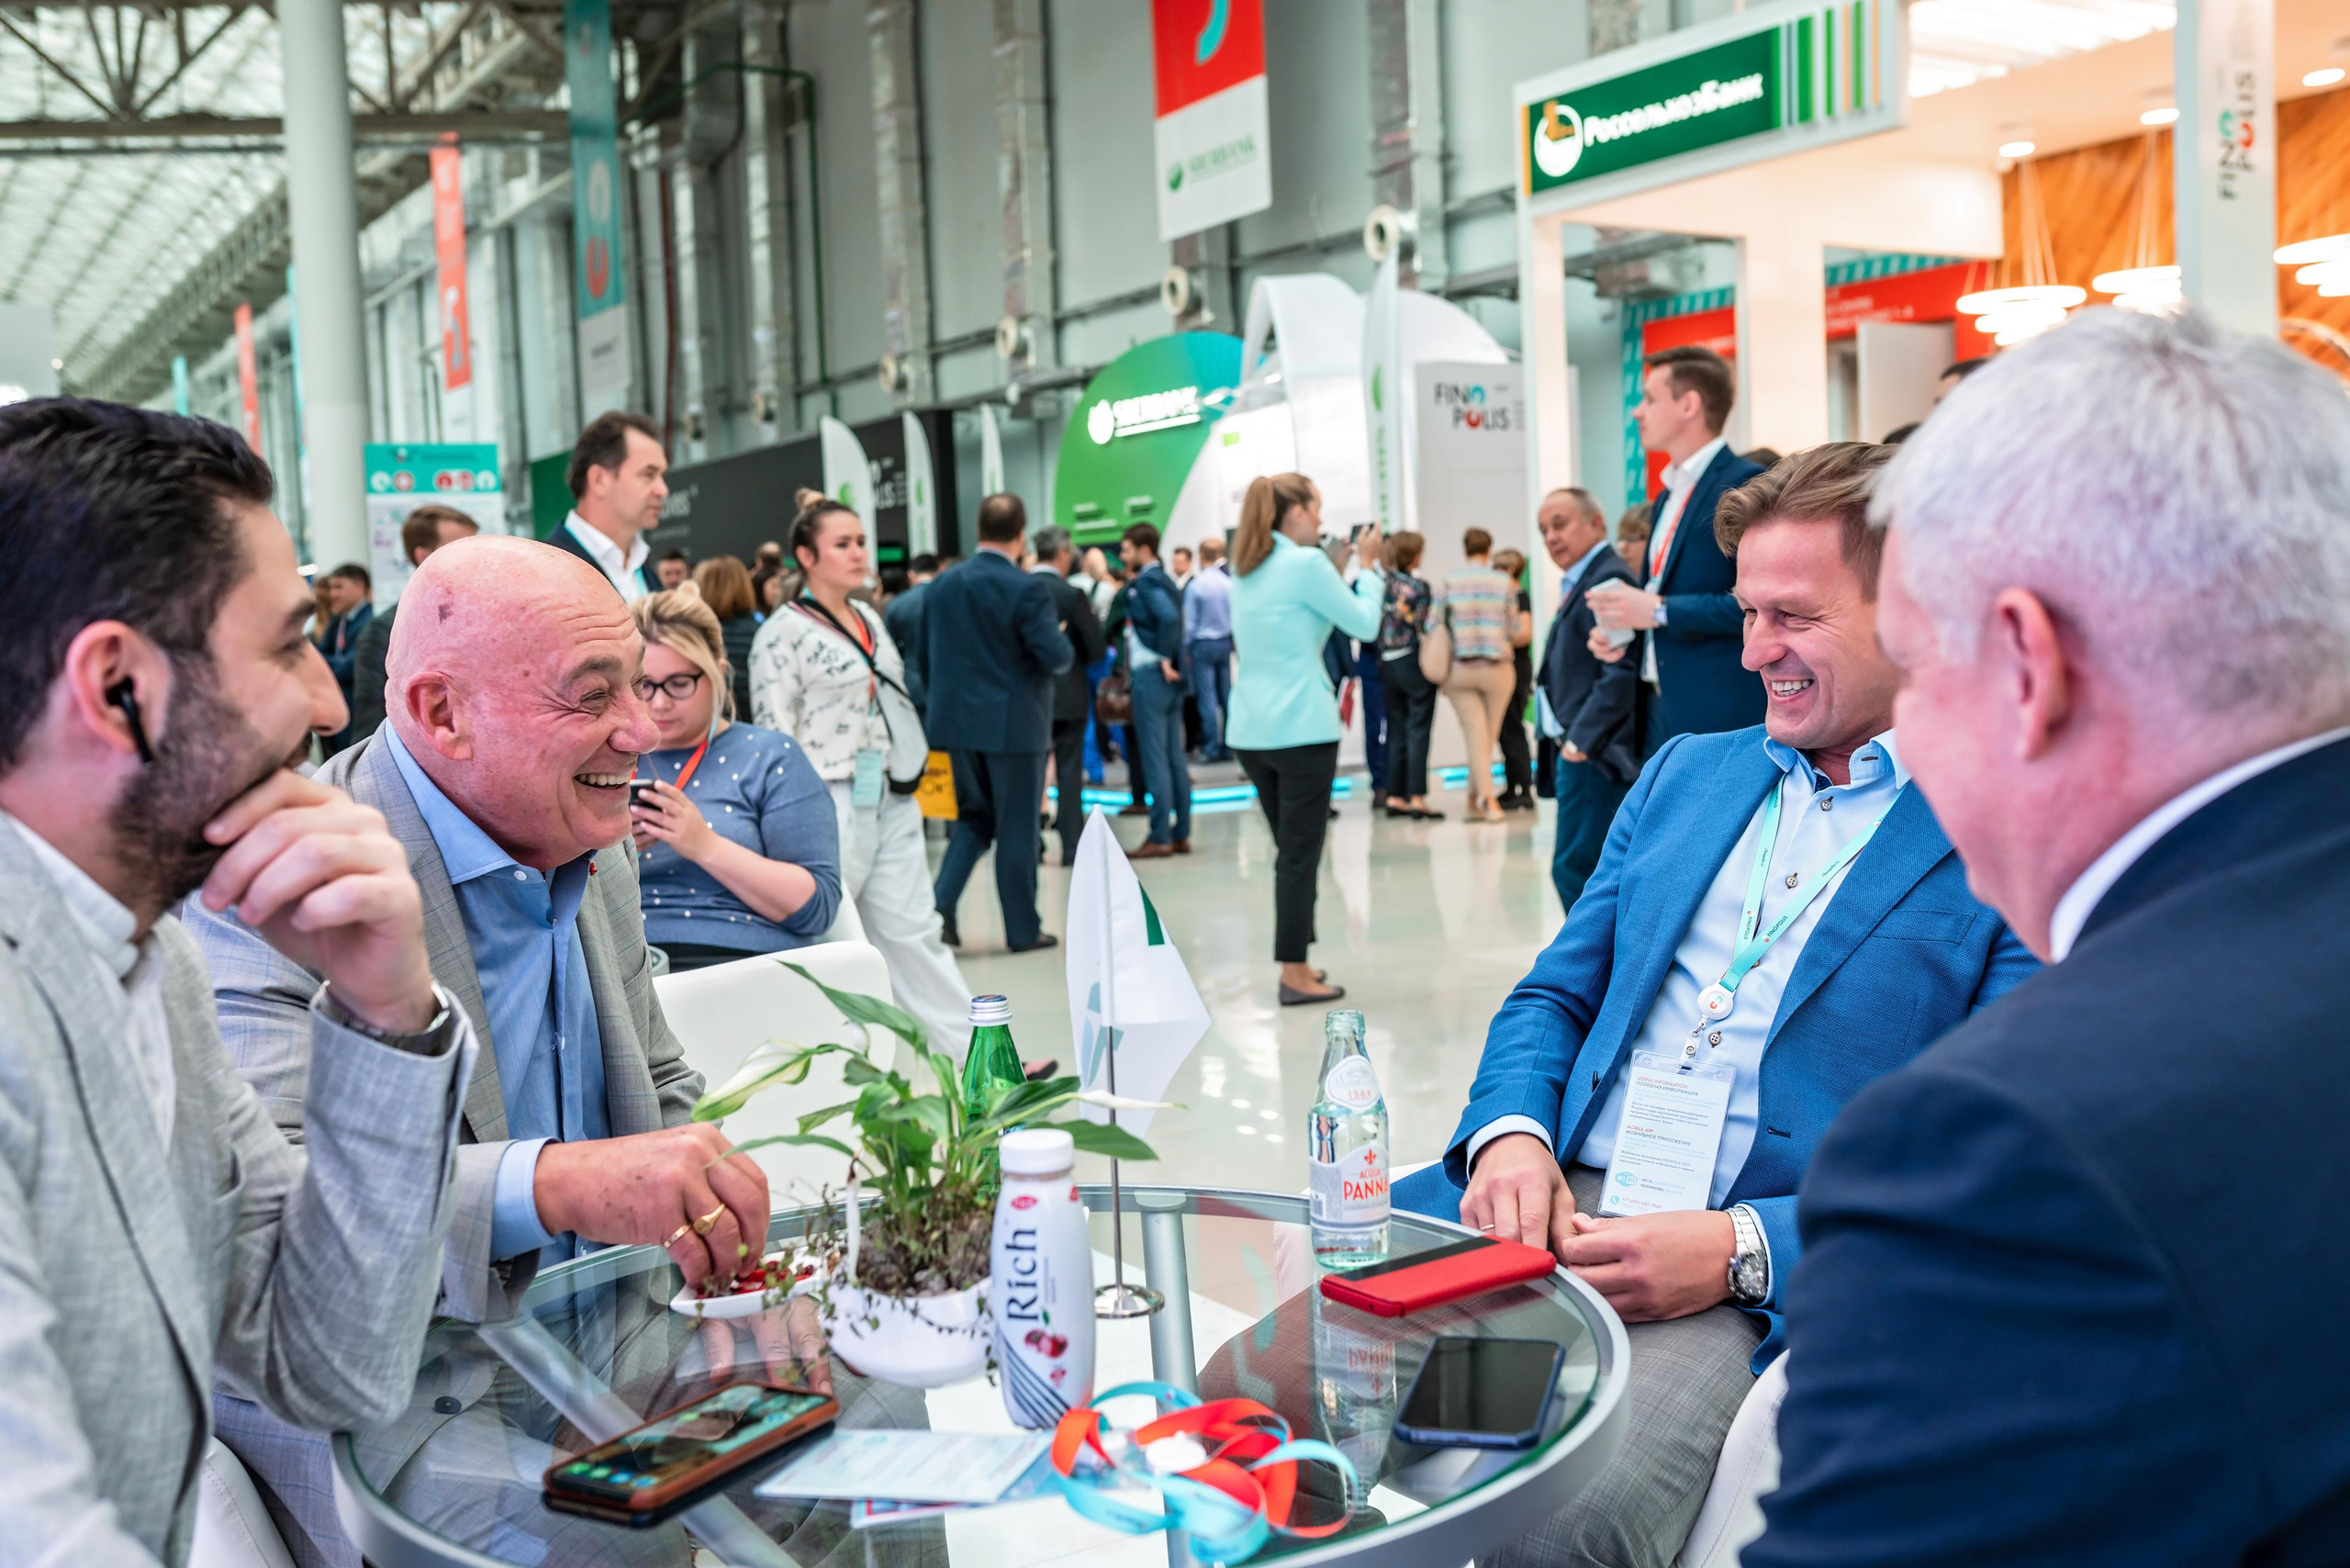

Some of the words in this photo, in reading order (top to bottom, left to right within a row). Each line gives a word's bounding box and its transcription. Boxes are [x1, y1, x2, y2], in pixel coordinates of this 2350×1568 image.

[1743, 916, 1752, 940] FINOPOLIS
[1766, 915, 1788, 937] FINOPOLIS
[1636, 1081, 1662, 1090] ПОЛЕЗНАЯ
[1662, 1086, 1698, 1096] ИНФОРМАЦИЯ
[1654, 1079, 1688, 1089] INFORMATION
[1626, 1129, 1656, 1139] МОБИЛЬНОЕ
[1657, 1136, 1691, 1146] ПРИЛОЖЕНИЕ
[1004, 1227, 1038, 1321] Rich
